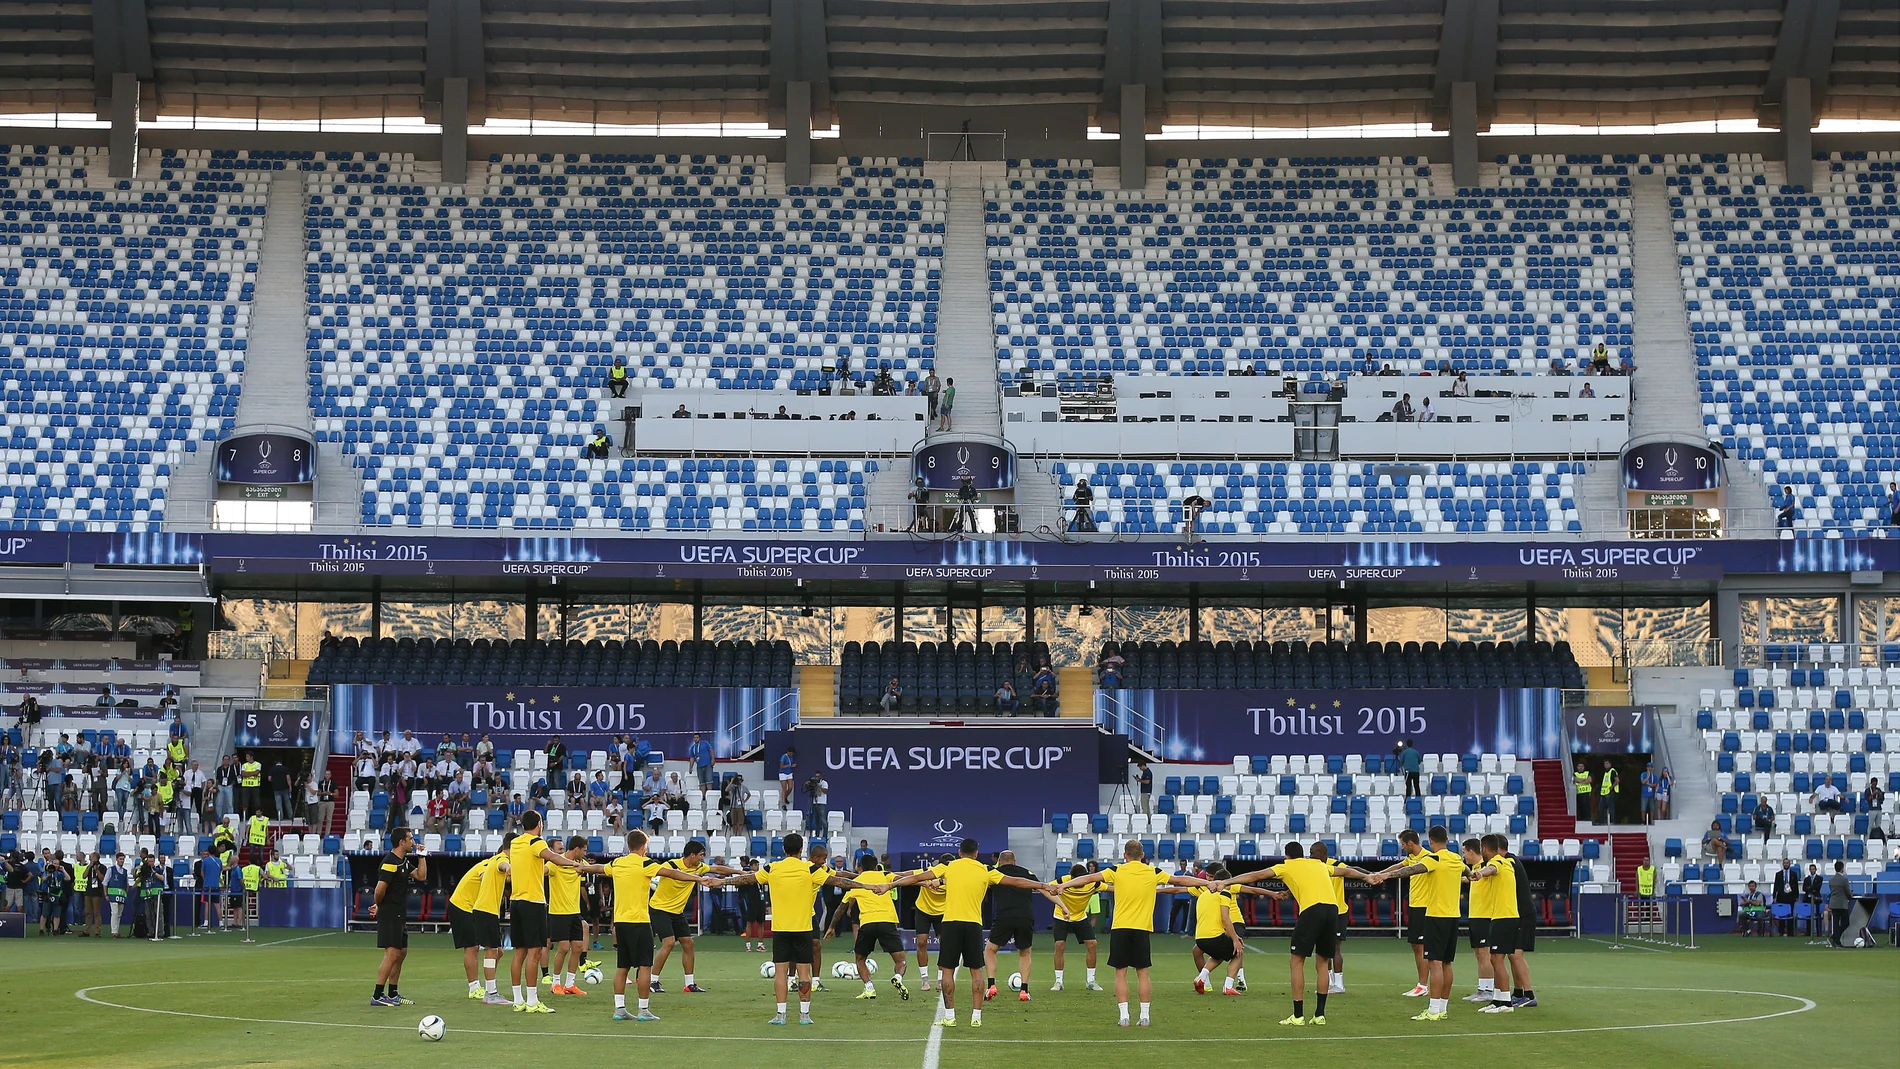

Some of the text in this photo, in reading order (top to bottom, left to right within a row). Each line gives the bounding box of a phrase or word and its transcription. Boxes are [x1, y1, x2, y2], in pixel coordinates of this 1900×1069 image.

[229, 449, 237, 461] 7
[293, 449, 301, 462] 8
[928, 456, 936, 468] 8
[991, 456, 1000, 469] 9
[1636, 457, 1644, 469] 9
[1695, 456, 1707, 470] 10
[319, 539, 428, 561] Tbilisi 2015
[680, 545, 737, 563] UEFA
[742, 546, 813, 564] SUPER
[1152, 545, 1261, 567] Tbilisi 2015
[1519, 548, 1576, 566] UEFA
[1581, 548, 1652, 566] SUPER
[309, 559, 365, 573] Tbilisi 2015
[502, 564, 531, 574] UEFA
[532, 564, 567, 575] SUPER
[737, 564, 793, 578] Tbilisi 2015
[905, 567, 934, 578] UEFA
[935, 567, 971, 579] SUPER
[1562, 565, 1619, 579] Tbilisi 2015
[1104, 567, 1160, 580] Tbilisi 2015
[1308, 569, 1337, 579] UEFA
[1345, 569, 1380, 579] SUPER
[465, 691, 646, 731] Tbilisi 2015
[1246, 697, 1427, 736] Tbilisi 2015
[246, 714, 257, 728] 5
[300, 715, 310, 729] 6
[1576, 713, 1587, 727] 6
[1631, 712, 1642, 727] 7
[825, 746, 901, 770] UEFA
[908, 746, 1003, 770] SUPER
